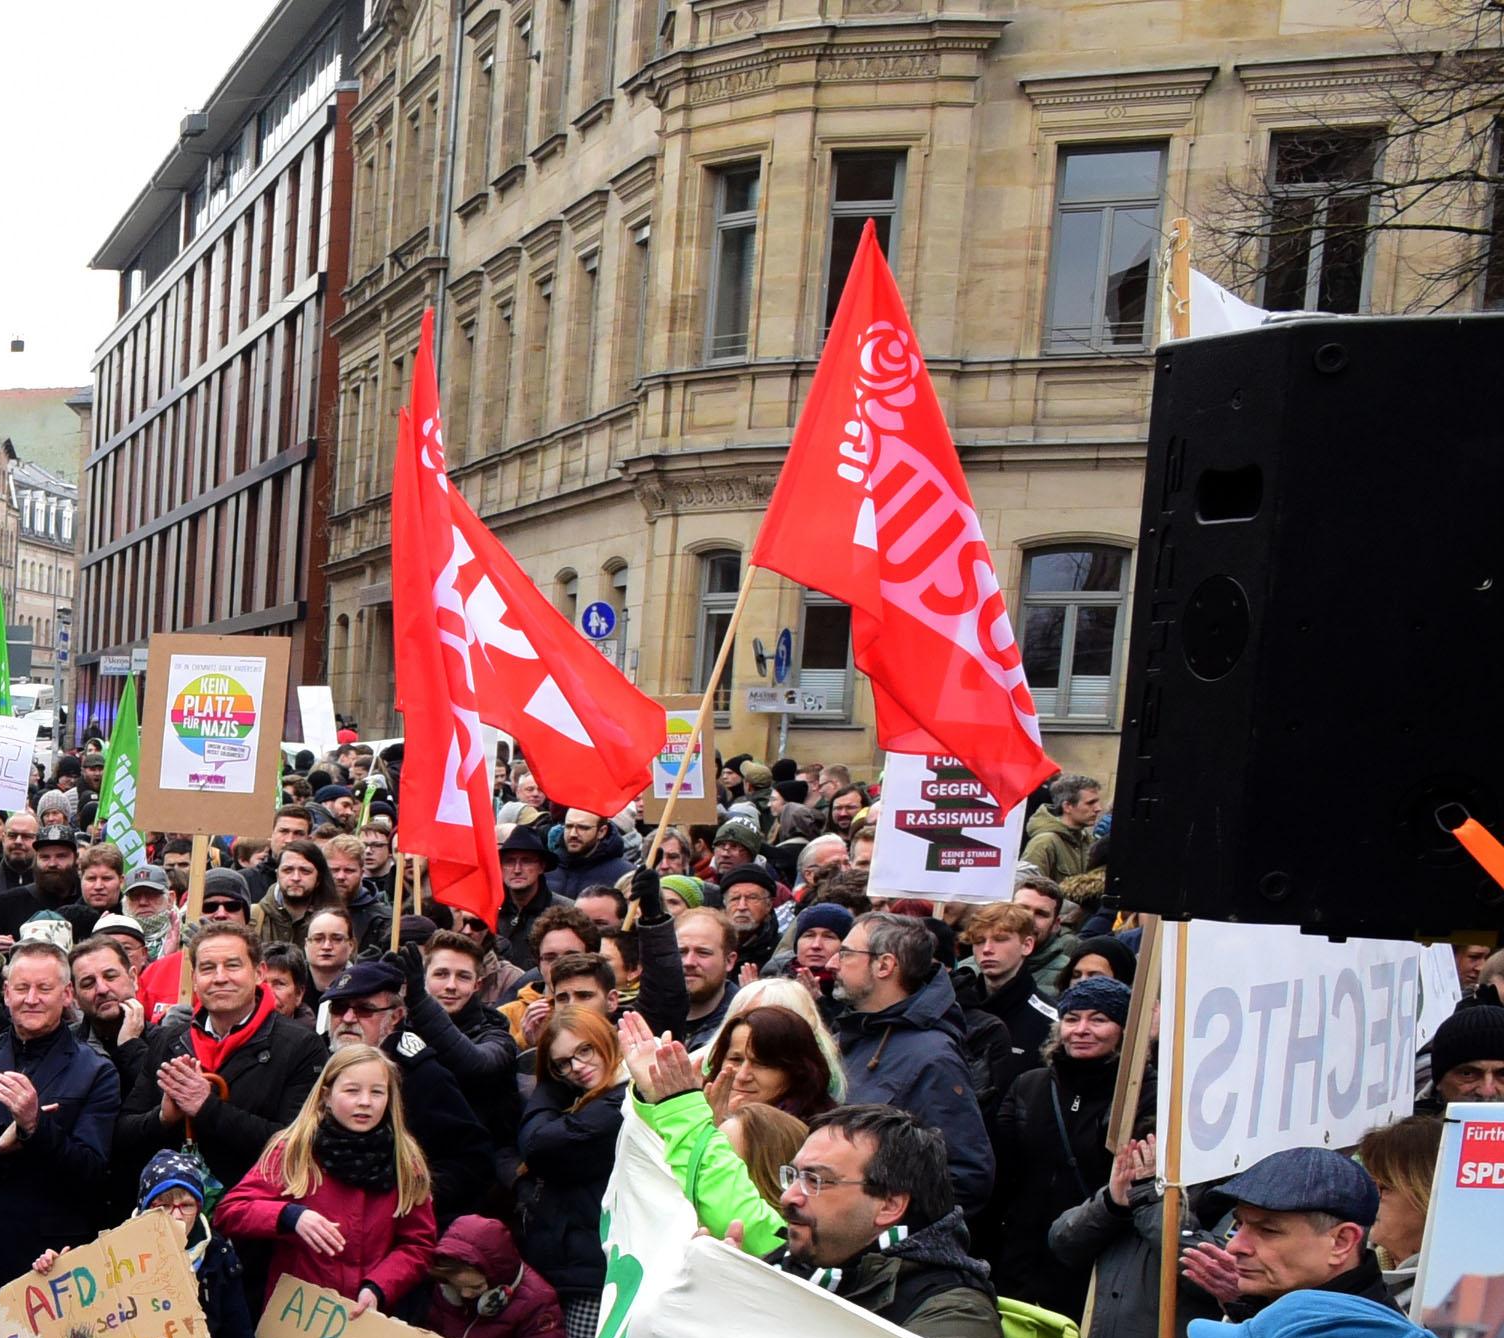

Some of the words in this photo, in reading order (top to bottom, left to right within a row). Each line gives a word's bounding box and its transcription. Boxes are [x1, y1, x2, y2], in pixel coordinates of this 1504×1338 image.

[200, 677, 229, 694] KEIN
[183, 695, 235, 718] PLATZ
[183, 716, 199, 729] FÜR
[200, 720, 239, 737] NAZIS
[927, 783, 982, 796] GEGEN
[906, 812, 994, 826] RASSISMUS
[105, 1246, 153, 1289] ihr
[96, 1296, 138, 1334] seid
[151, 1298, 172, 1312] so
